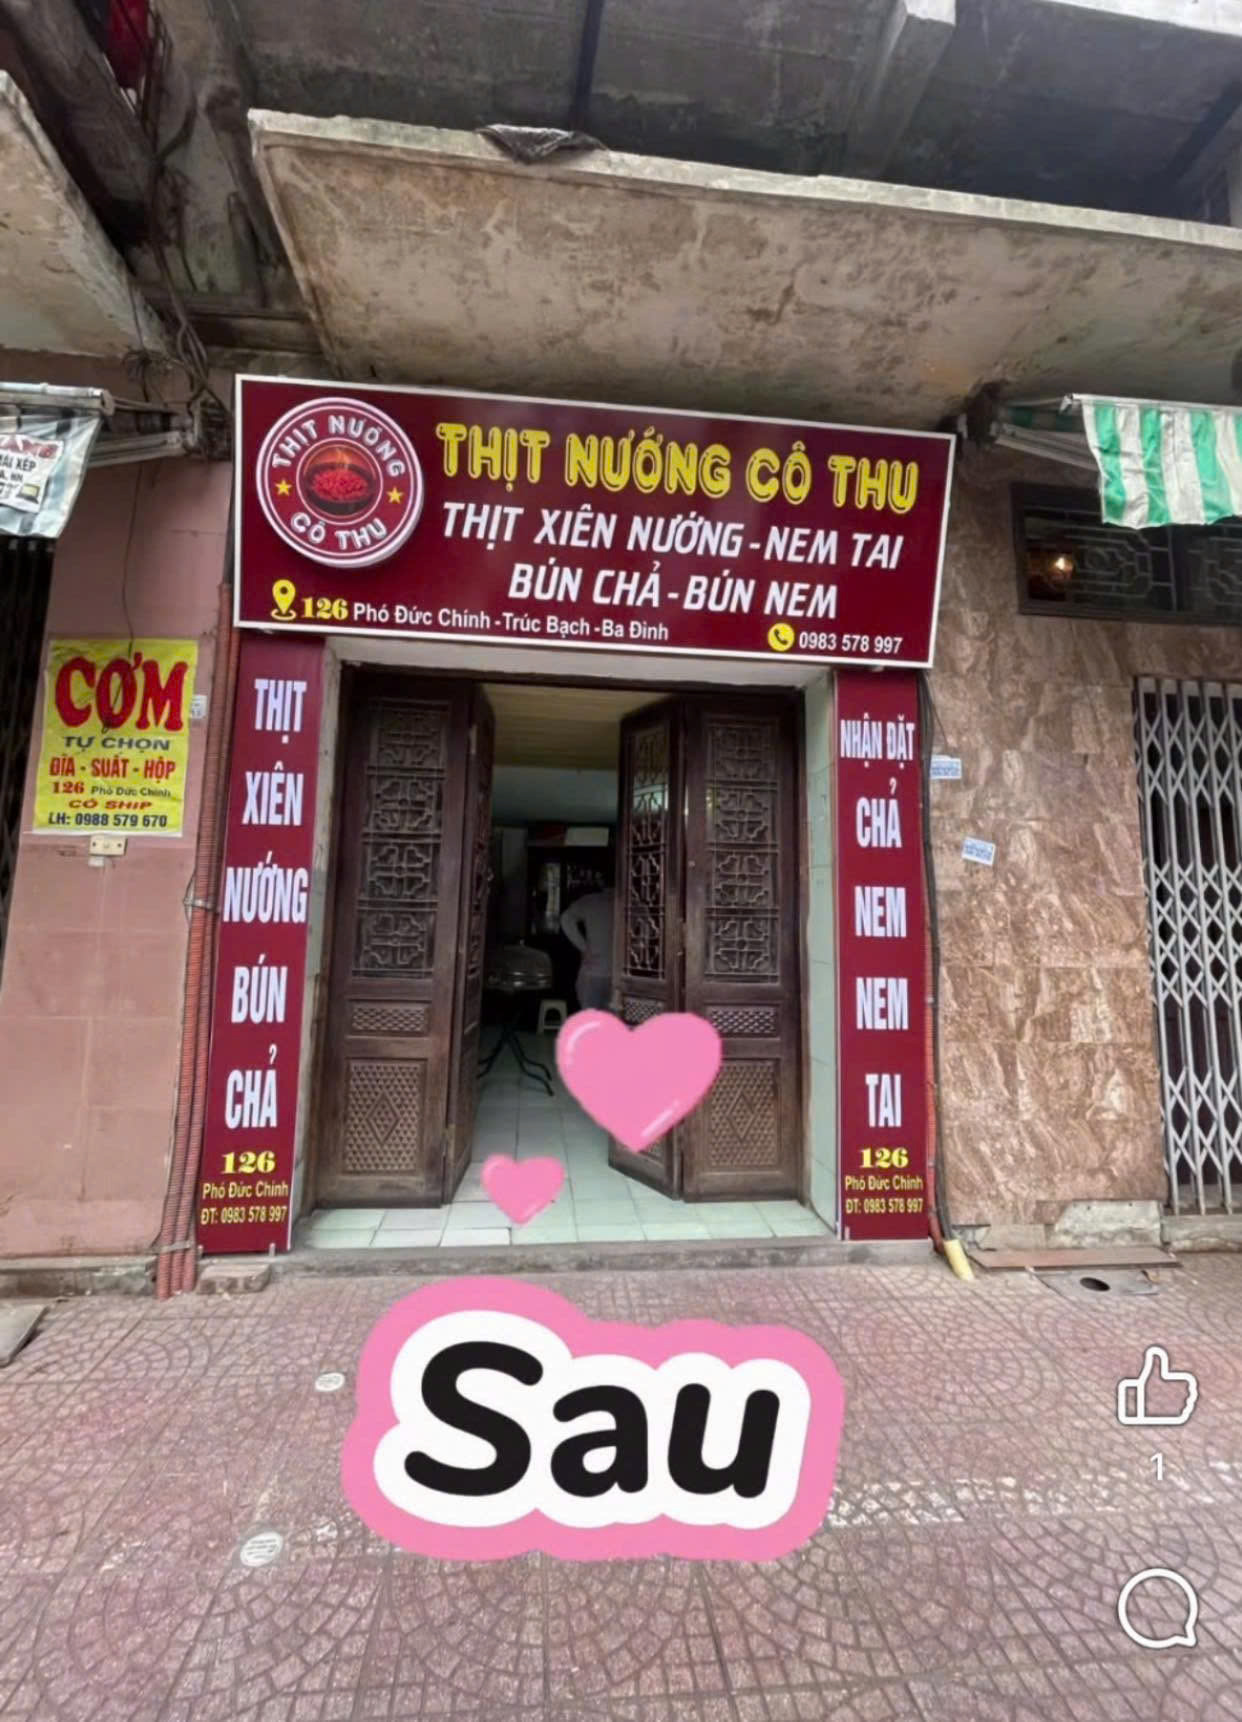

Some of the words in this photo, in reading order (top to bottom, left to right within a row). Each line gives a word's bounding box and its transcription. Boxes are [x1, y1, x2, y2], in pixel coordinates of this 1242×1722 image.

[436, 423, 551, 492] THỊT
[565, 426, 731, 499] NƯỚNG
[746, 441, 812, 505] CÔ
[828, 455, 919, 514] THU
[291, 512, 326, 543] CÔ
[335, 518, 387, 550] THU
[443, 502, 524, 551] THỊT
[534, 503, 617, 549] XIÊN
[627, 512, 744, 558] NƯỚNG
[764, 526, 838, 566] NEM
[851, 533, 904, 570] TAI
[508, 557, 582, 602] BÚN
[592, 561, 661, 608] CHẢ
[683, 570, 755, 614] BÚN
[764, 581, 837, 620] NEM
[301, 597, 348, 621] 126
[353, 602, 390, 623] Phó
[394, 604, 433, 626] Đức
[546, 614, 590, 639] Bạch
[799, 632, 836, 650] 0983
[842, 635, 870, 653] 578
[874, 636, 903, 654] 997
[55, 651, 188, 731] CƠM
[254, 678, 307, 744] THỊT
[64, 736, 95, 752] TỰ
[101, 736, 170, 753] CHỌN
[840, 713, 882, 768] NHẬN
[886, 715, 915, 769] ĐẶT
[52, 781, 84, 794] 126
[91, 752, 129, 778] SUẤT
[143, 756, 176, 784] HỘP
[242, 761, 304, 826] XIÊN
[48, 812, 71, 825] LH:
[75, 812, 109, 826] 0988
[113, 814, 138, 827] 579
[142, 815, 168, 828] 670
[104, 800, 152, 810] SHIP
[856, 777, 902, 848] CHẢ
[223, 851, 308, 923] NƯỚNG
[855, 886, 907, 938] NEM
[231, 954, 287, 1024] BÚN
[856, 977, 908, 1030] NEM
[225, 1044, 279, 1129] CHẢ
[865, 1073, 901, 1127] TAI
[221, 1151, 276, 1174] 126
[859, 1148, 908, 1168] 126
[200, 1207, 218, 1225] ĐT:
[220, 1206, 246, 1223] 0983
[247, 1205, 267, 1223] 578
[268, 1205, 288, 1222] 997
[228, 1180, 253, 1198] Đức
[863, 1197, 887, 1214] 0983
[888, 1197, 905, 1213] 578
[907, 1197, 924, 1213] 997
